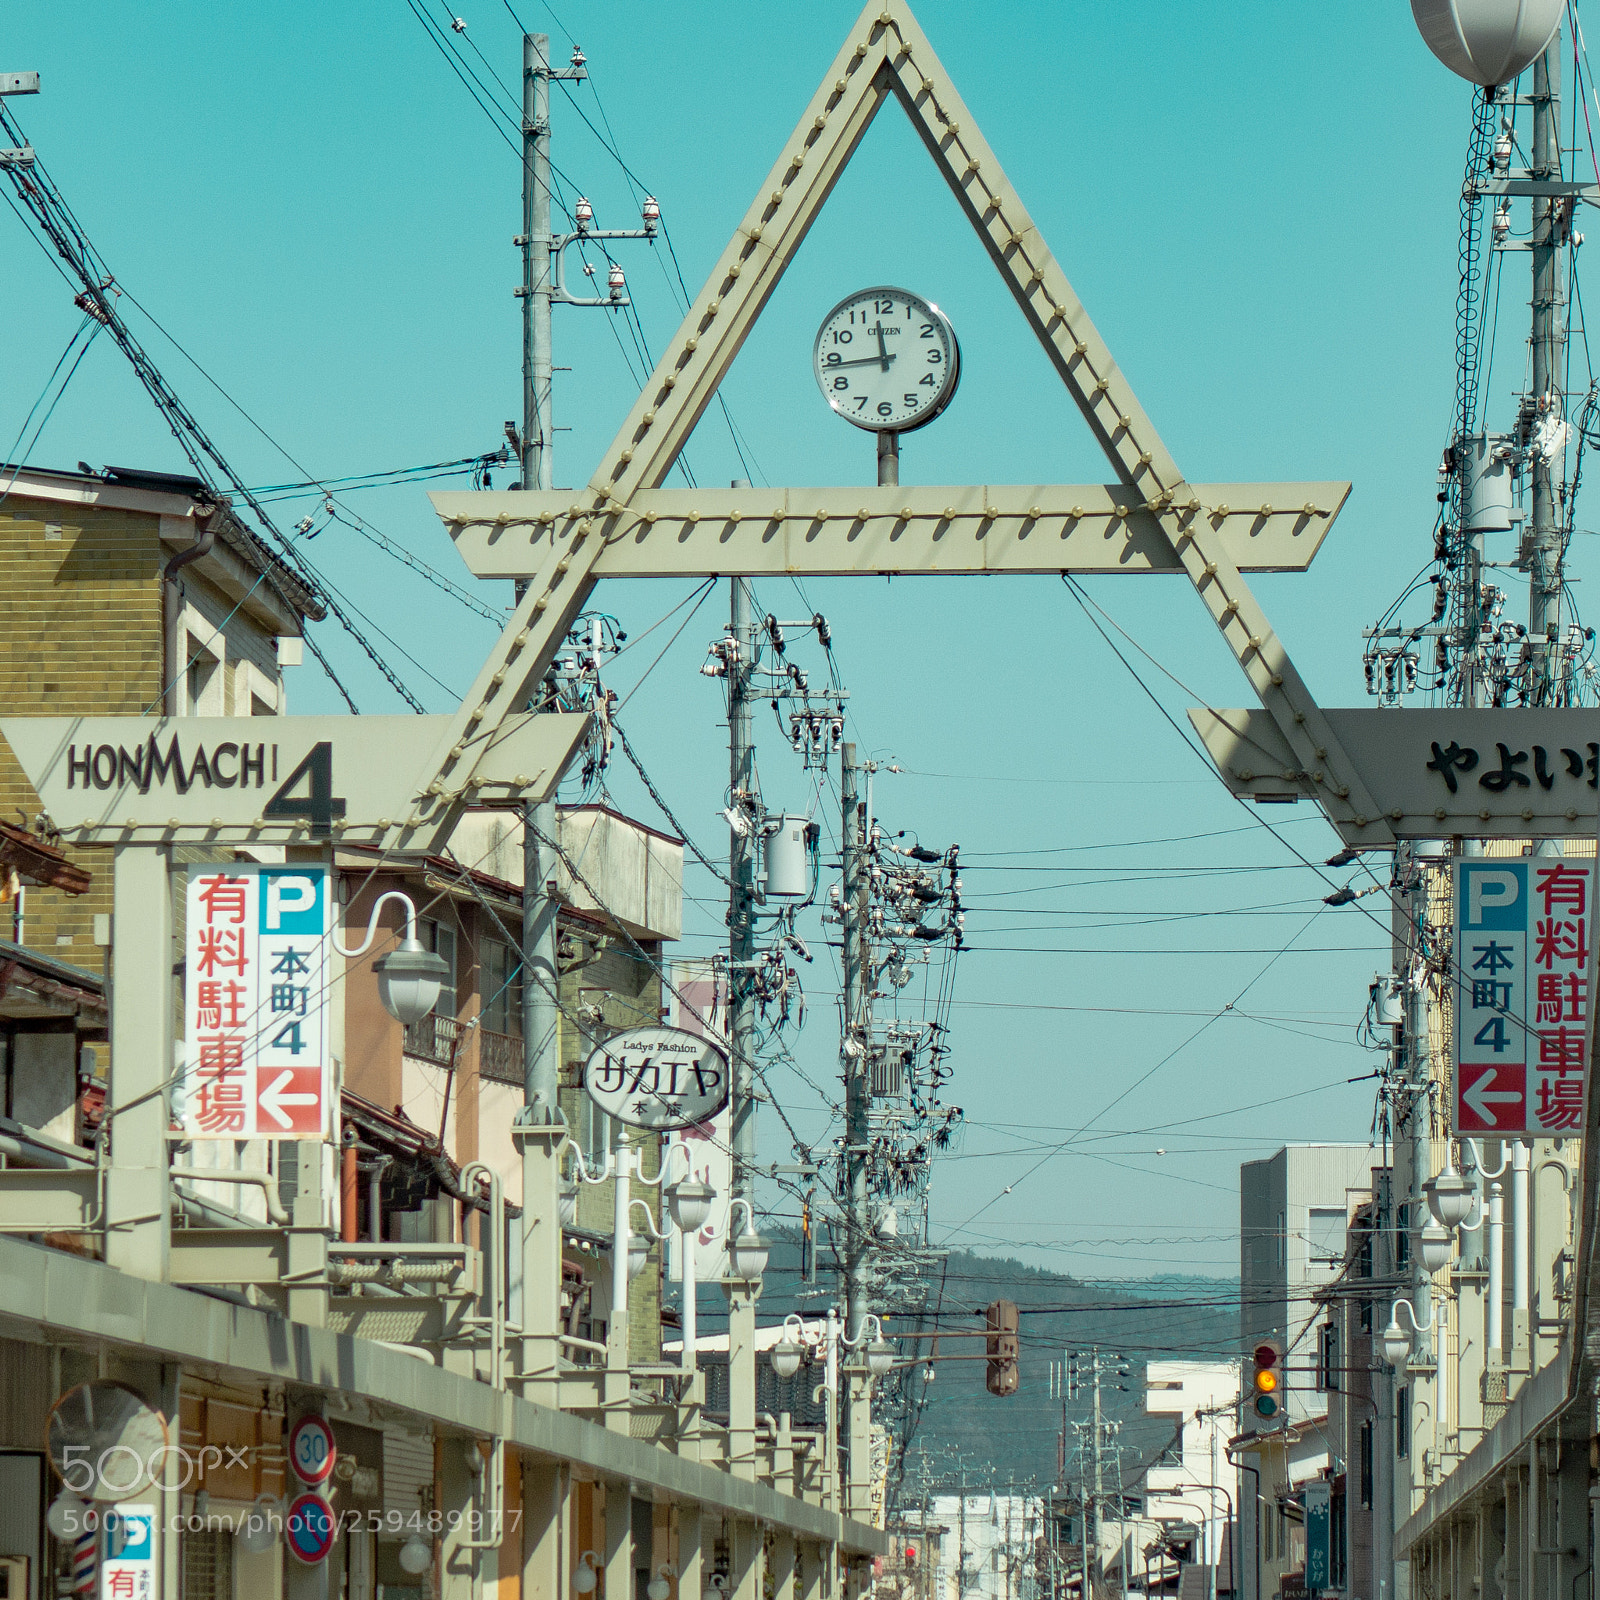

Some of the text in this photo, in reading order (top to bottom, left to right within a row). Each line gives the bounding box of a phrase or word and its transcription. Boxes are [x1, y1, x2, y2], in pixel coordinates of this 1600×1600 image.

[874, 300, 893, 314] 12
[906, 306, 911, 320] 1
[849, 310, 866, 324] 11
[833, 330, 853, 344] 10
[867, 327, 901, 335] CIIZEN
[920, 324, 934, 338] 2
[827, 352, 842, 366] 9
[927, 349, 942, 363] 3
[834, 376, 849, 390] 8
[919, 373, 935, 387] 4
[853, 396, 868, 410] 7
[904, 394, 919, 408] 5
[877, 402, 892, 416] 6
[67, 731, 346, 838] HONMACHI 4
[266, 876, 316, 929] P
[1468, 870, 1518, 924] P
[194, 873, 249, 1133] 有料駐車場
[270, 946, 312, 1054] 本町4
[1472, 940, 1514, 1052] 本町4
[1534, 864, 1590, 1131] 有料駐車場
[623, 1040, 696, 1054] Ladys Fashion
[595, 1055, 720, 1096] サカエヤ
[300, 1434, 324, 1463] 30
